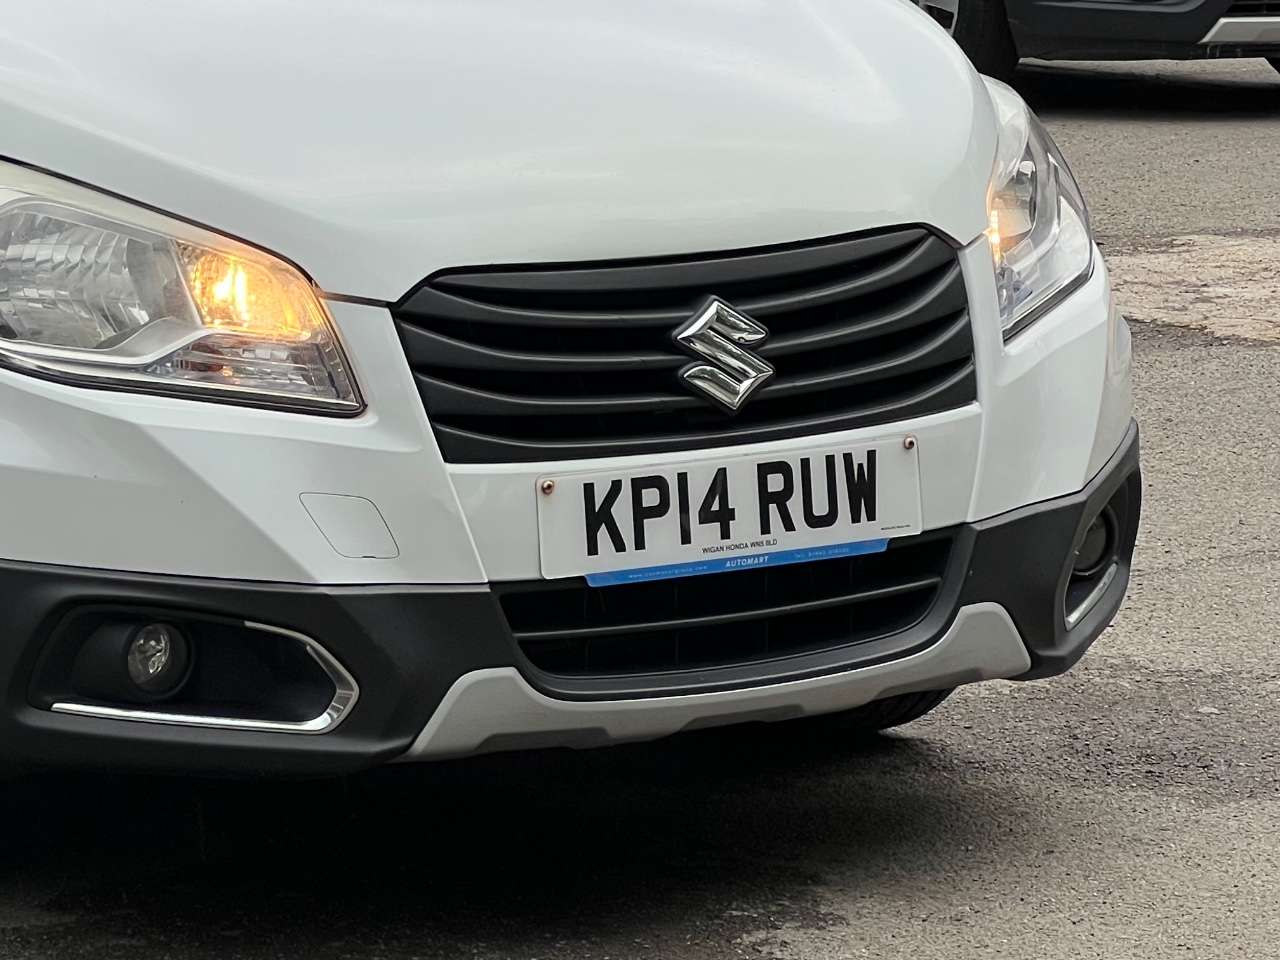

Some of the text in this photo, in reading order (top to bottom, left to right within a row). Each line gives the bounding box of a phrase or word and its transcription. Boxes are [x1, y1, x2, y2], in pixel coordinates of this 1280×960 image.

[583, 449, 877, 556] KP14 RUW
[701, 545, 724, 553] WIGAN
[726, 542, 749, 551] HONDA
[726, 555, 769, 568] AUTOMART
